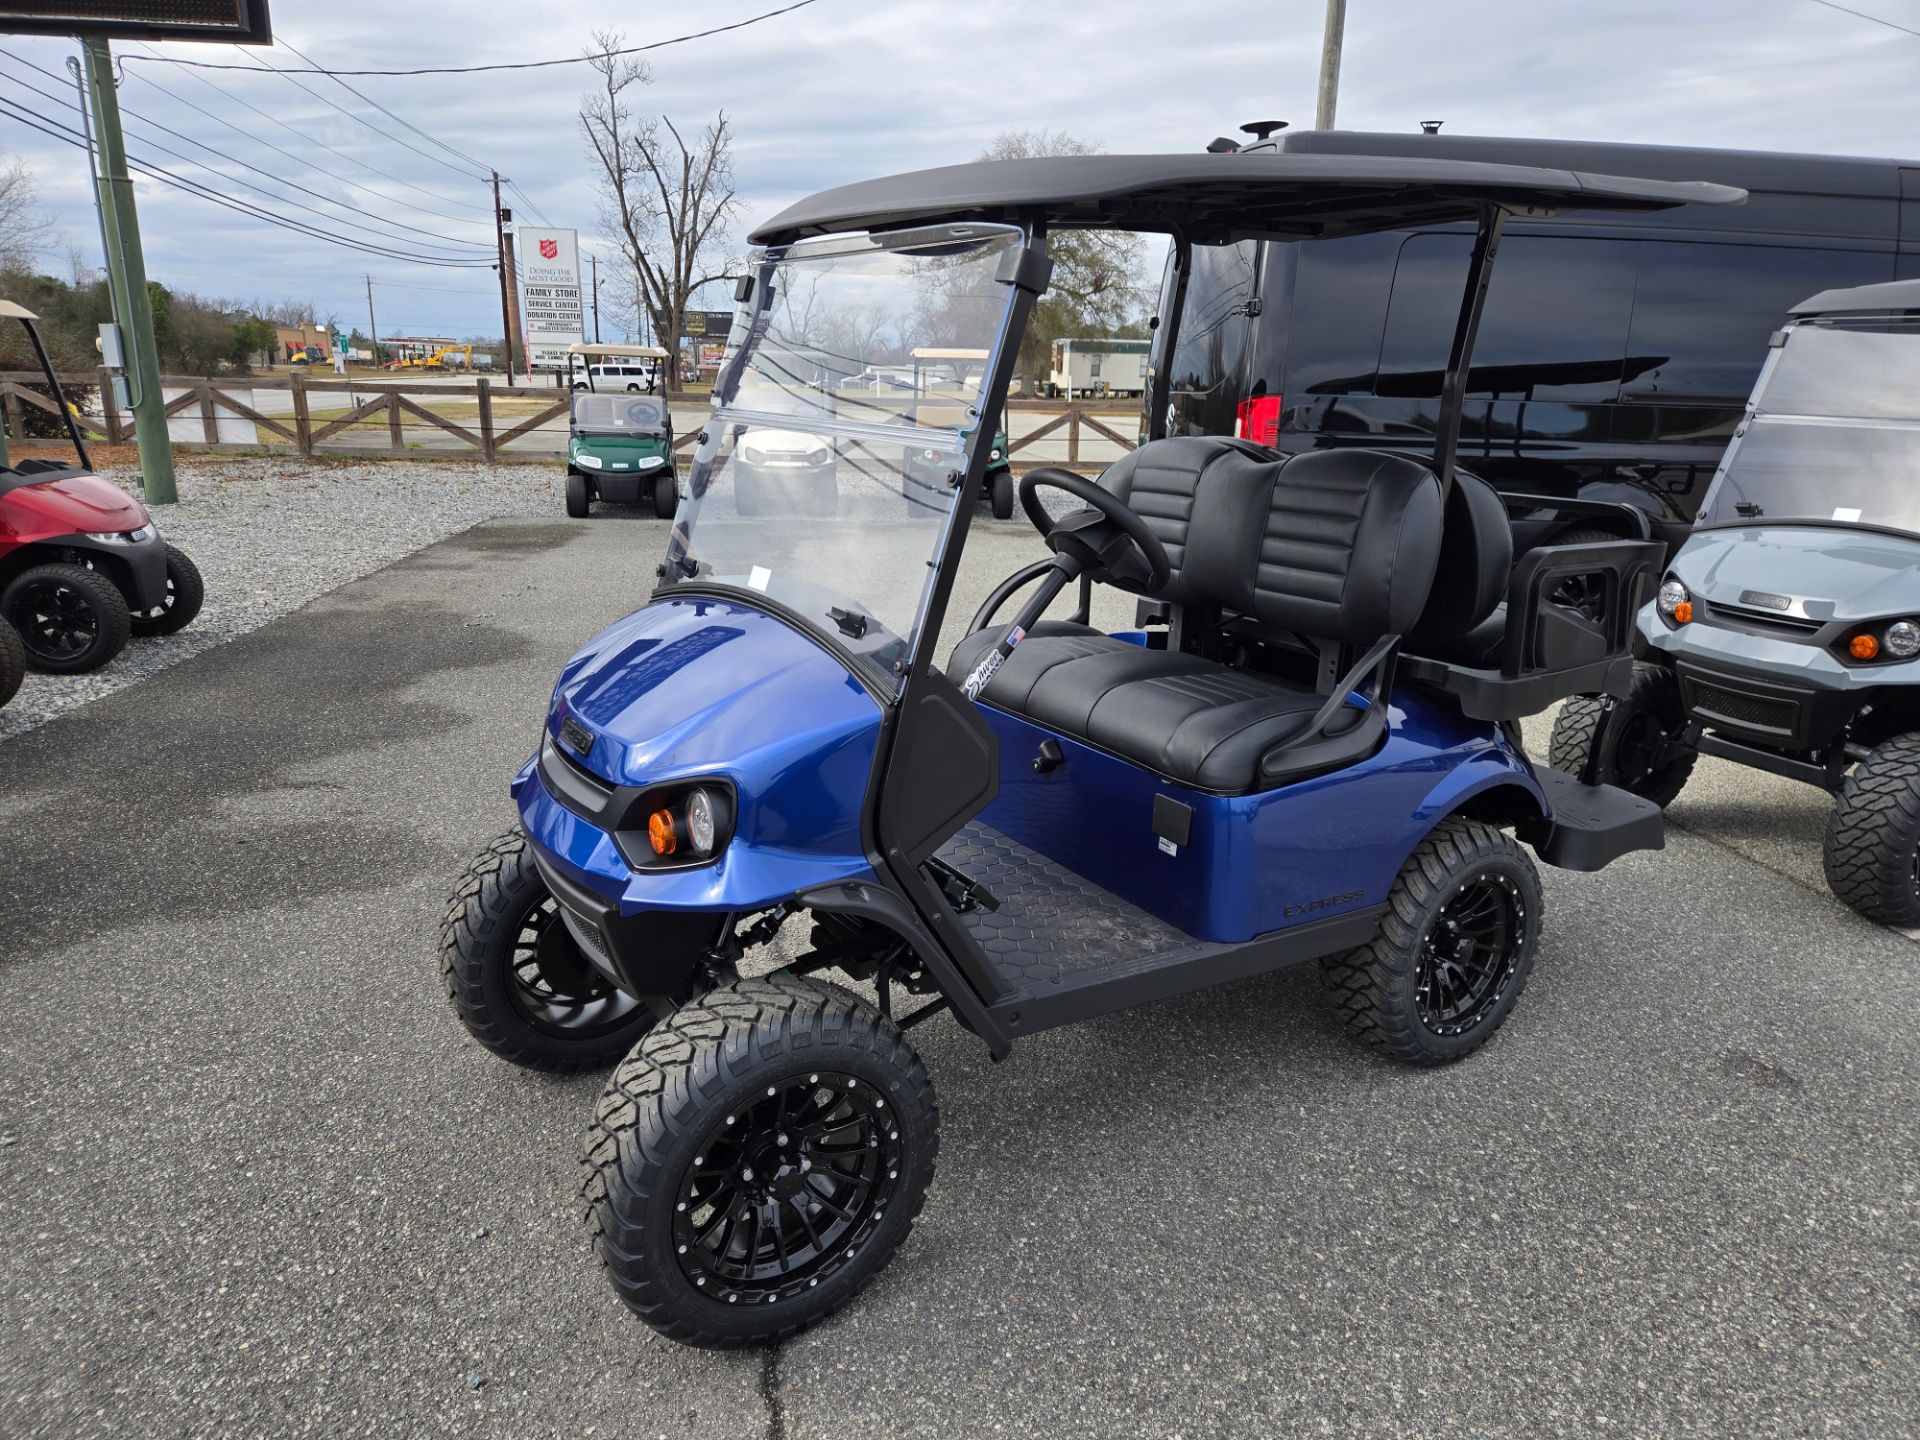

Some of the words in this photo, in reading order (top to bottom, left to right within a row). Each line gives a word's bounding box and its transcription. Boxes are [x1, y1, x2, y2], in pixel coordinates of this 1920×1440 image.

[526, 288, 552, 298] FAMILY
[555, 289, 578, 298] STORE
[528, 300, 552, 308] SERVICE
[555, 301, 578, 309] CENTER
[527, 311, 557, 319] DONATION
[559, 312, 581, 320] CENTER
[1283, 890, 1365, 918] EXPRESS
